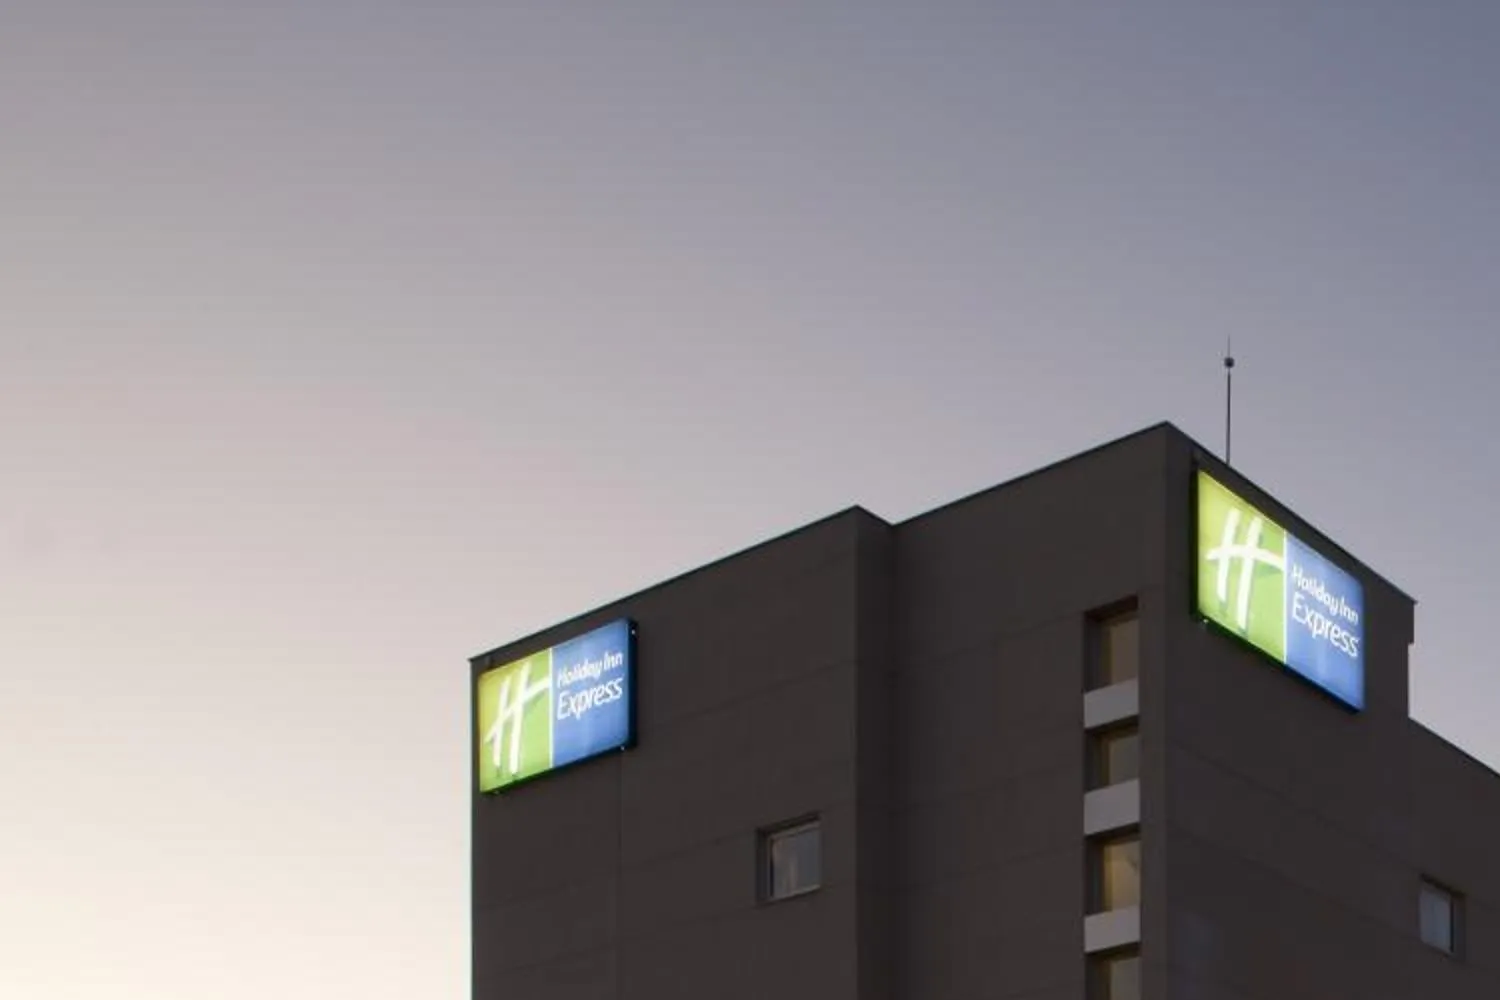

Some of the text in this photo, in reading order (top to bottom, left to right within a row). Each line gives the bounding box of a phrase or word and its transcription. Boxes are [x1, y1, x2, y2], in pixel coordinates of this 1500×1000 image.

[1292, 563, 1359, 626] Holiday Inn
[1293, 591, 1359, 657] Express
[557, 651, 623, 689] Holiday Inn
[557, 677, 623, 720] Express
